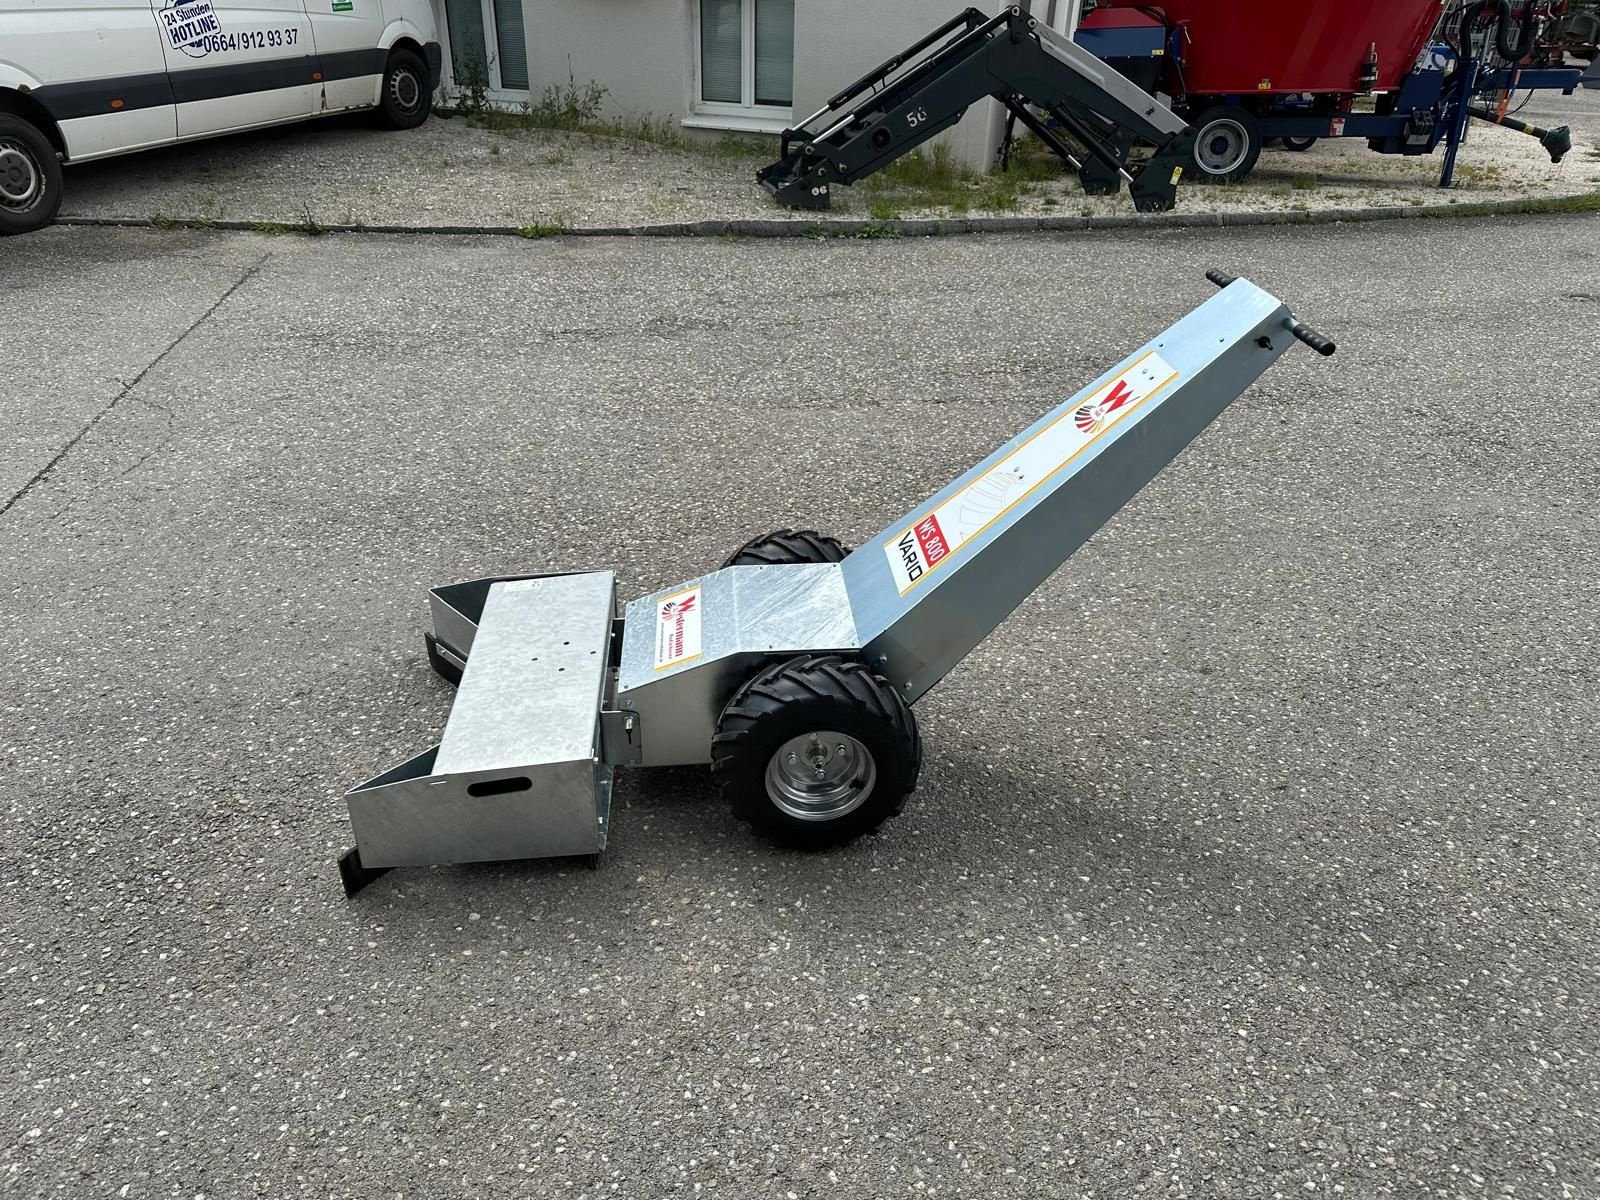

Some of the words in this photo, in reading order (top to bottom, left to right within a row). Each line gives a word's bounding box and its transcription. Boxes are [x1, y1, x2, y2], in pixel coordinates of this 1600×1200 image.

[164, 12, 177, 26] 24
[176, 3, 210, 22] Stunden
[170, 14, 218, 44] HOTLINE
[203, 31, 265, 53] 0664/912
[267, 29, 282, 47] 93
[284, 28, 298, 45] 37
[917, 517, 937, 540] WS
[898, 531, 923, 582] VARIO
[924, 536, 945, 562] 800
[675, 594, 697, 658] Westermann
